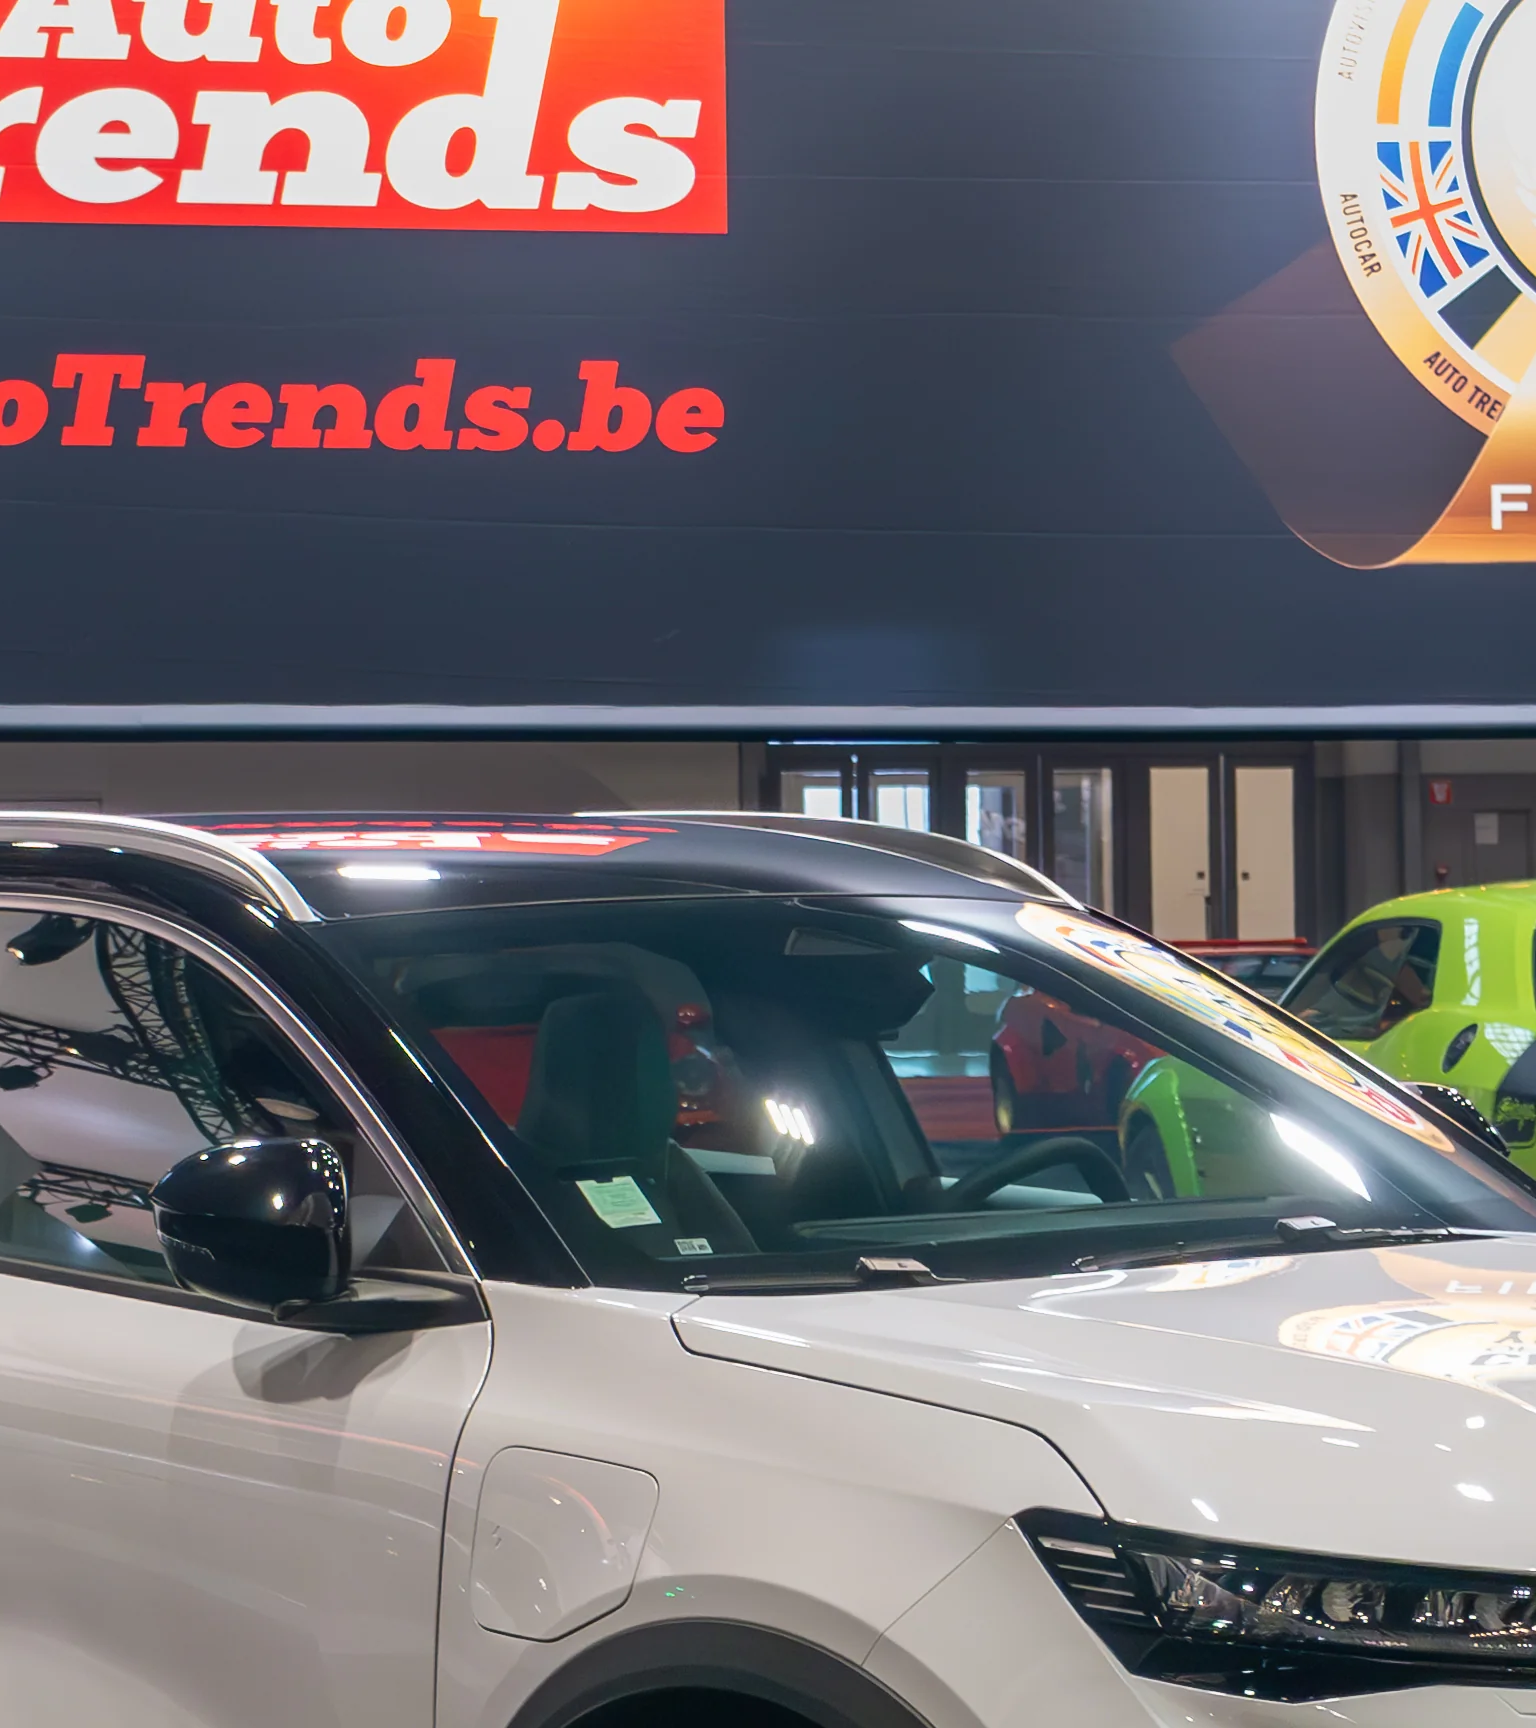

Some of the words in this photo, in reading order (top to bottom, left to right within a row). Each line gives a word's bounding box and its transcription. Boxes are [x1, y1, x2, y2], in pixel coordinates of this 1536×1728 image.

[1340, 193, 1382, 277] AUTOCAR
[1423, 351, 1468, 393] AUTO
[1467, 385, 1505, 422] TRE
